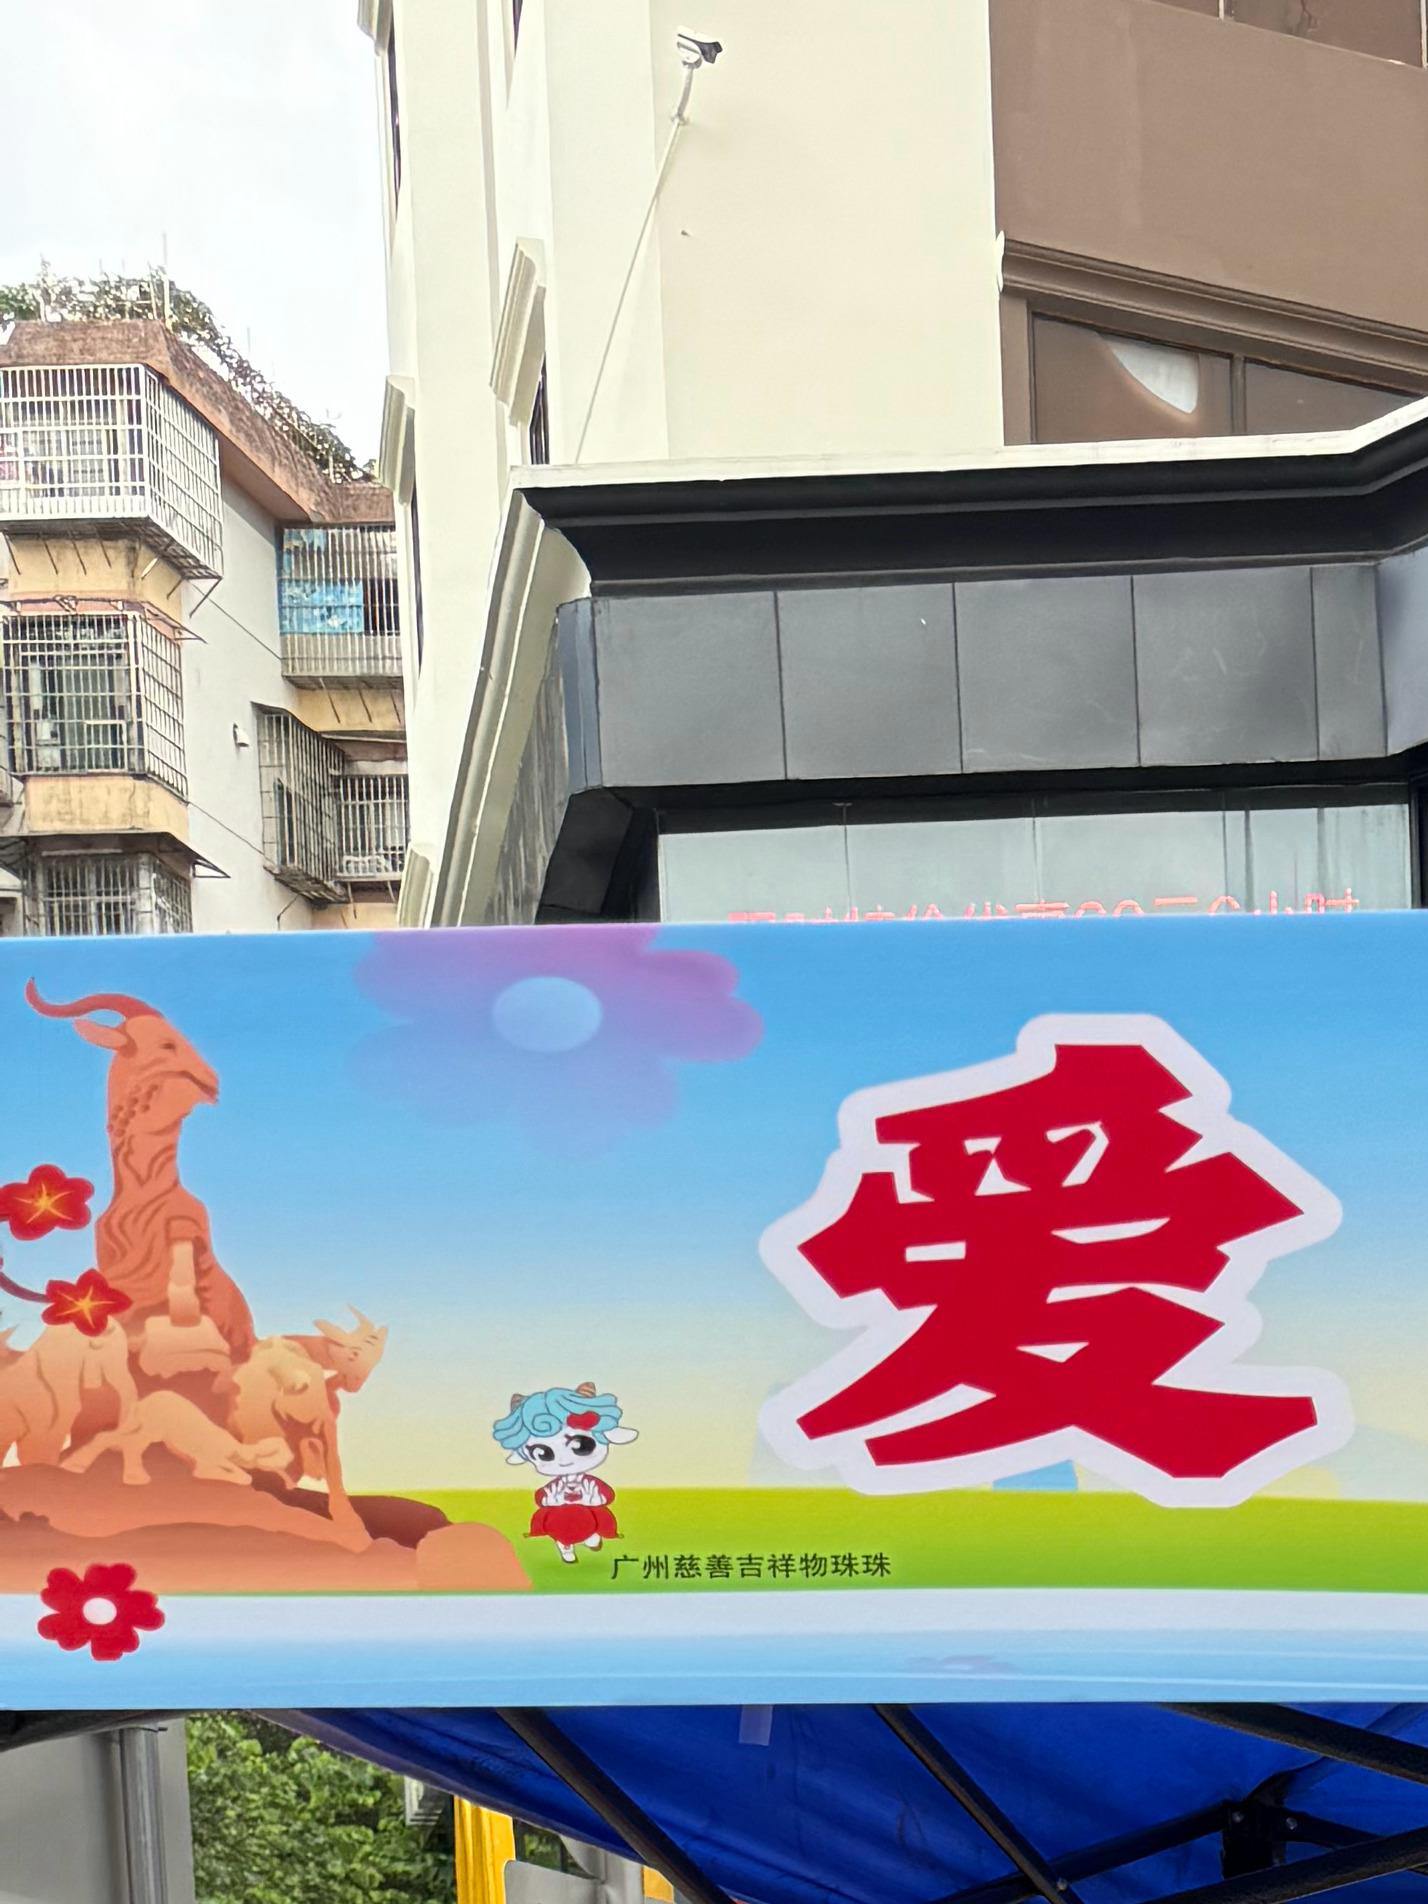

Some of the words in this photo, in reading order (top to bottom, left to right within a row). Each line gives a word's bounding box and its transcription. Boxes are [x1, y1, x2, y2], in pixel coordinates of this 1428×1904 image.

[611, 1552, 892, 1580] 广州慈善吉祥物珠珠
